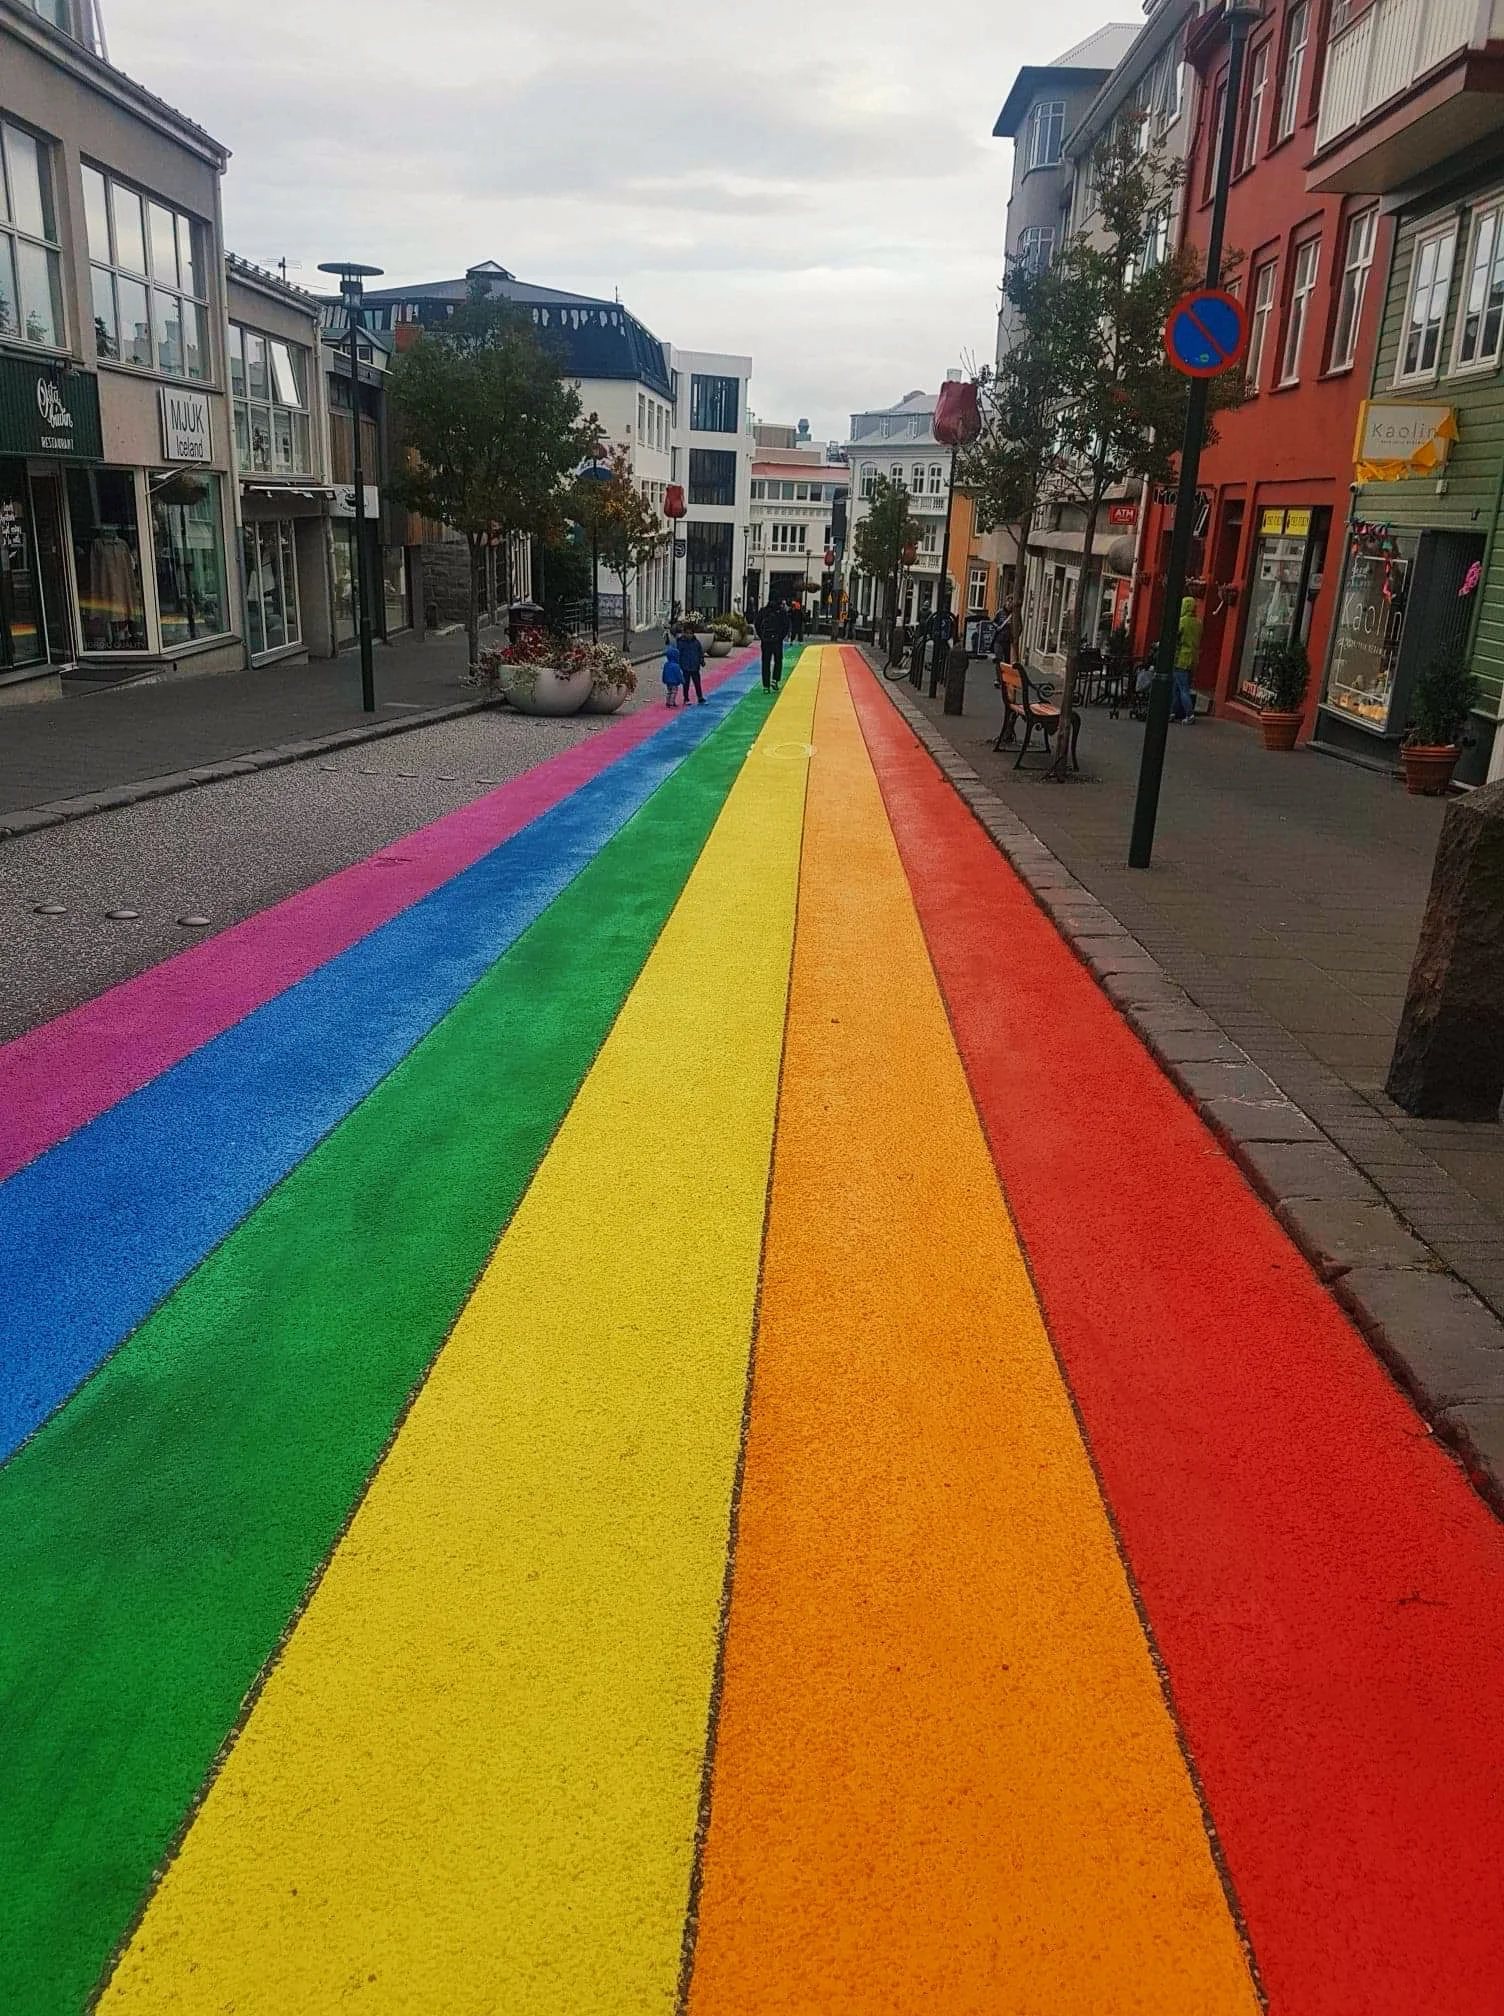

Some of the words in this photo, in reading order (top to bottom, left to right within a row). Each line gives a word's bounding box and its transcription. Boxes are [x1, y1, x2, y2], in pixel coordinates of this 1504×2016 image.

[170, 395, 205, 434] MJÚK
[1371, 422, 1437, 439] Kaolin
[40, 436, 74, 450] RESTAURANT
[176, 435, 204, 457] Iceland
[1114, 509, 1134, 519] ATM
[1341, 592, 1402, 642] Kaolin
